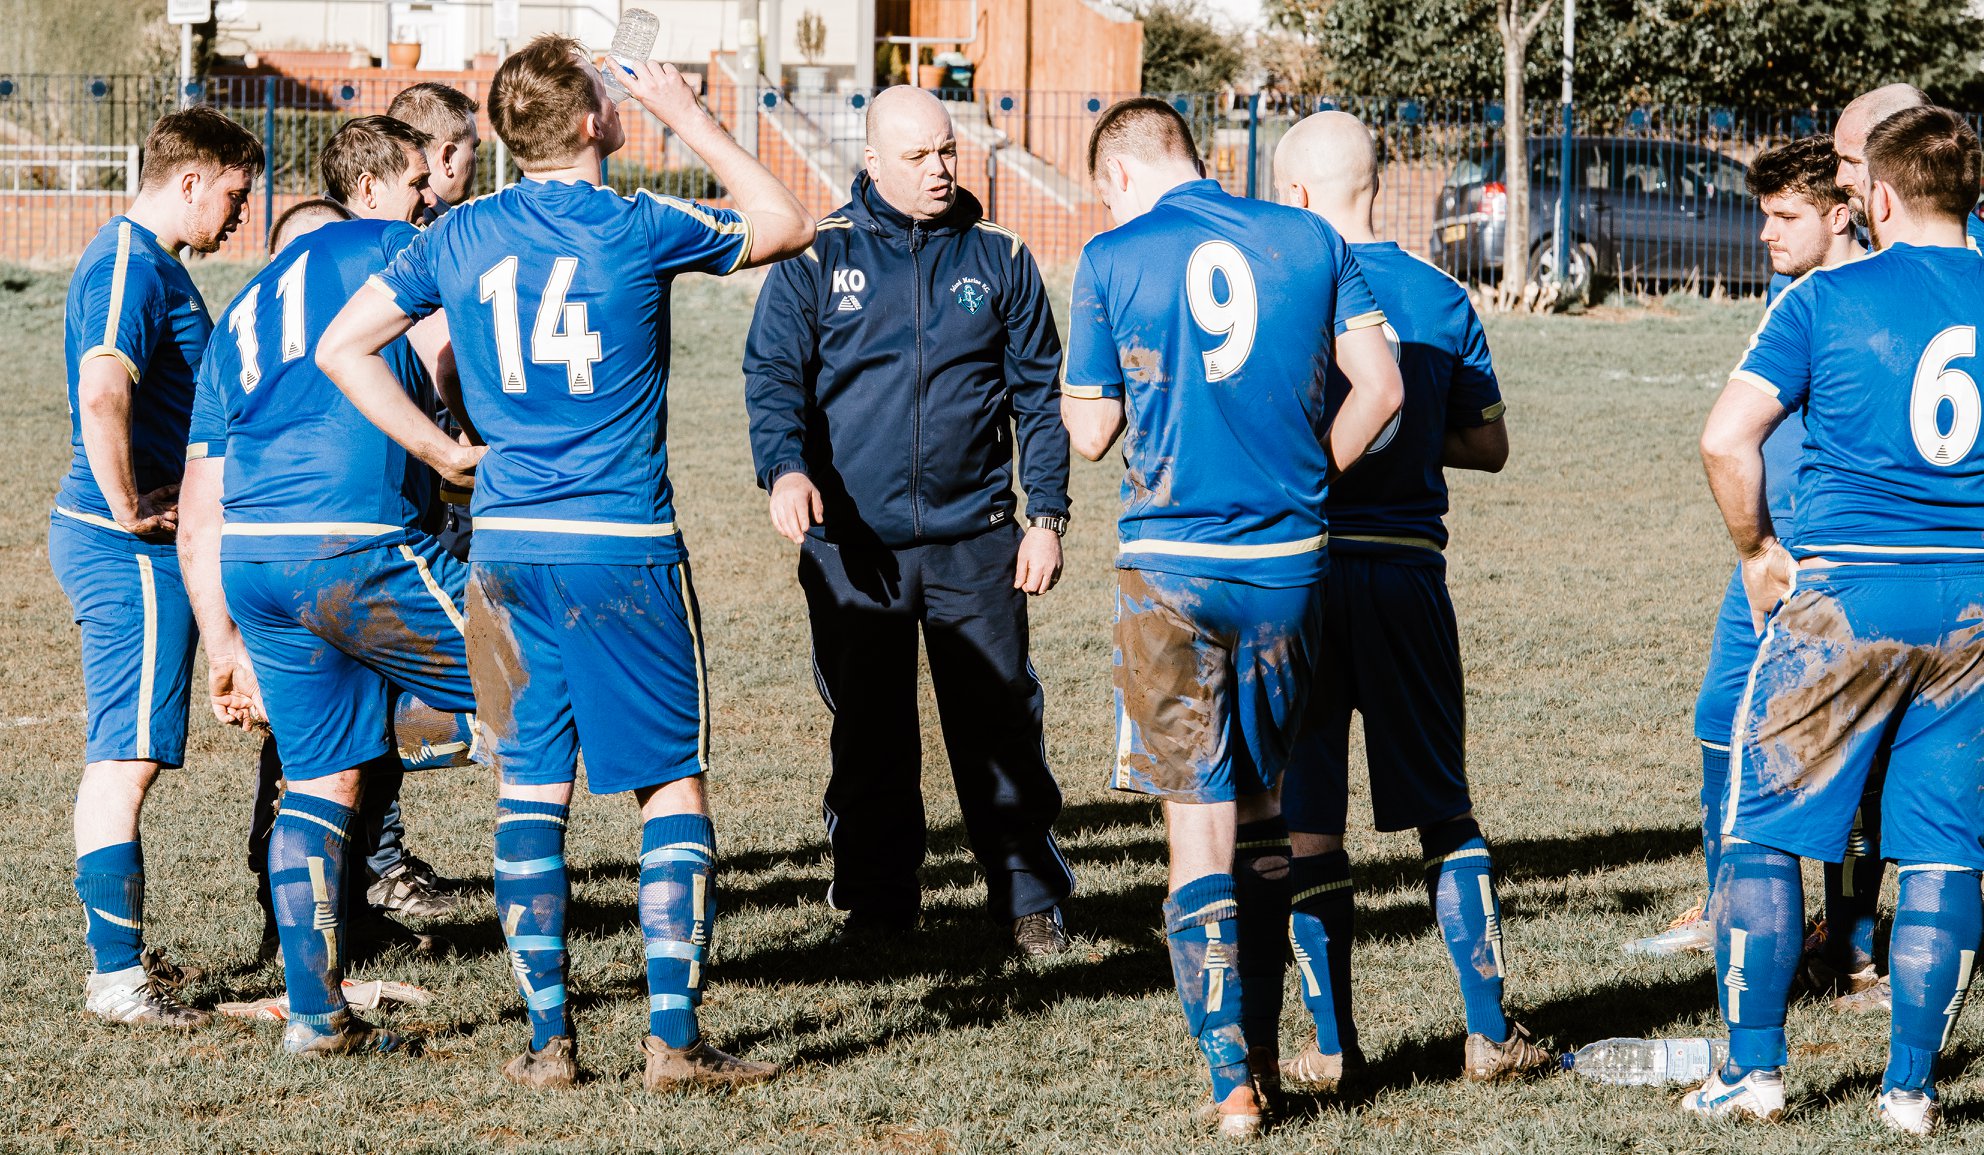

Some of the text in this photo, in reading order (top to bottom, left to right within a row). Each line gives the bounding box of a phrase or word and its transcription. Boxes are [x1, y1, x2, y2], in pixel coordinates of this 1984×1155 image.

[228, 249, 310, 394] 11
[480, 256, 602, 394] 14
[833, 268, 866, 292] KO
[1186, 240, 1257, 382] 9
[1909, 325, 1982, 467] 6
